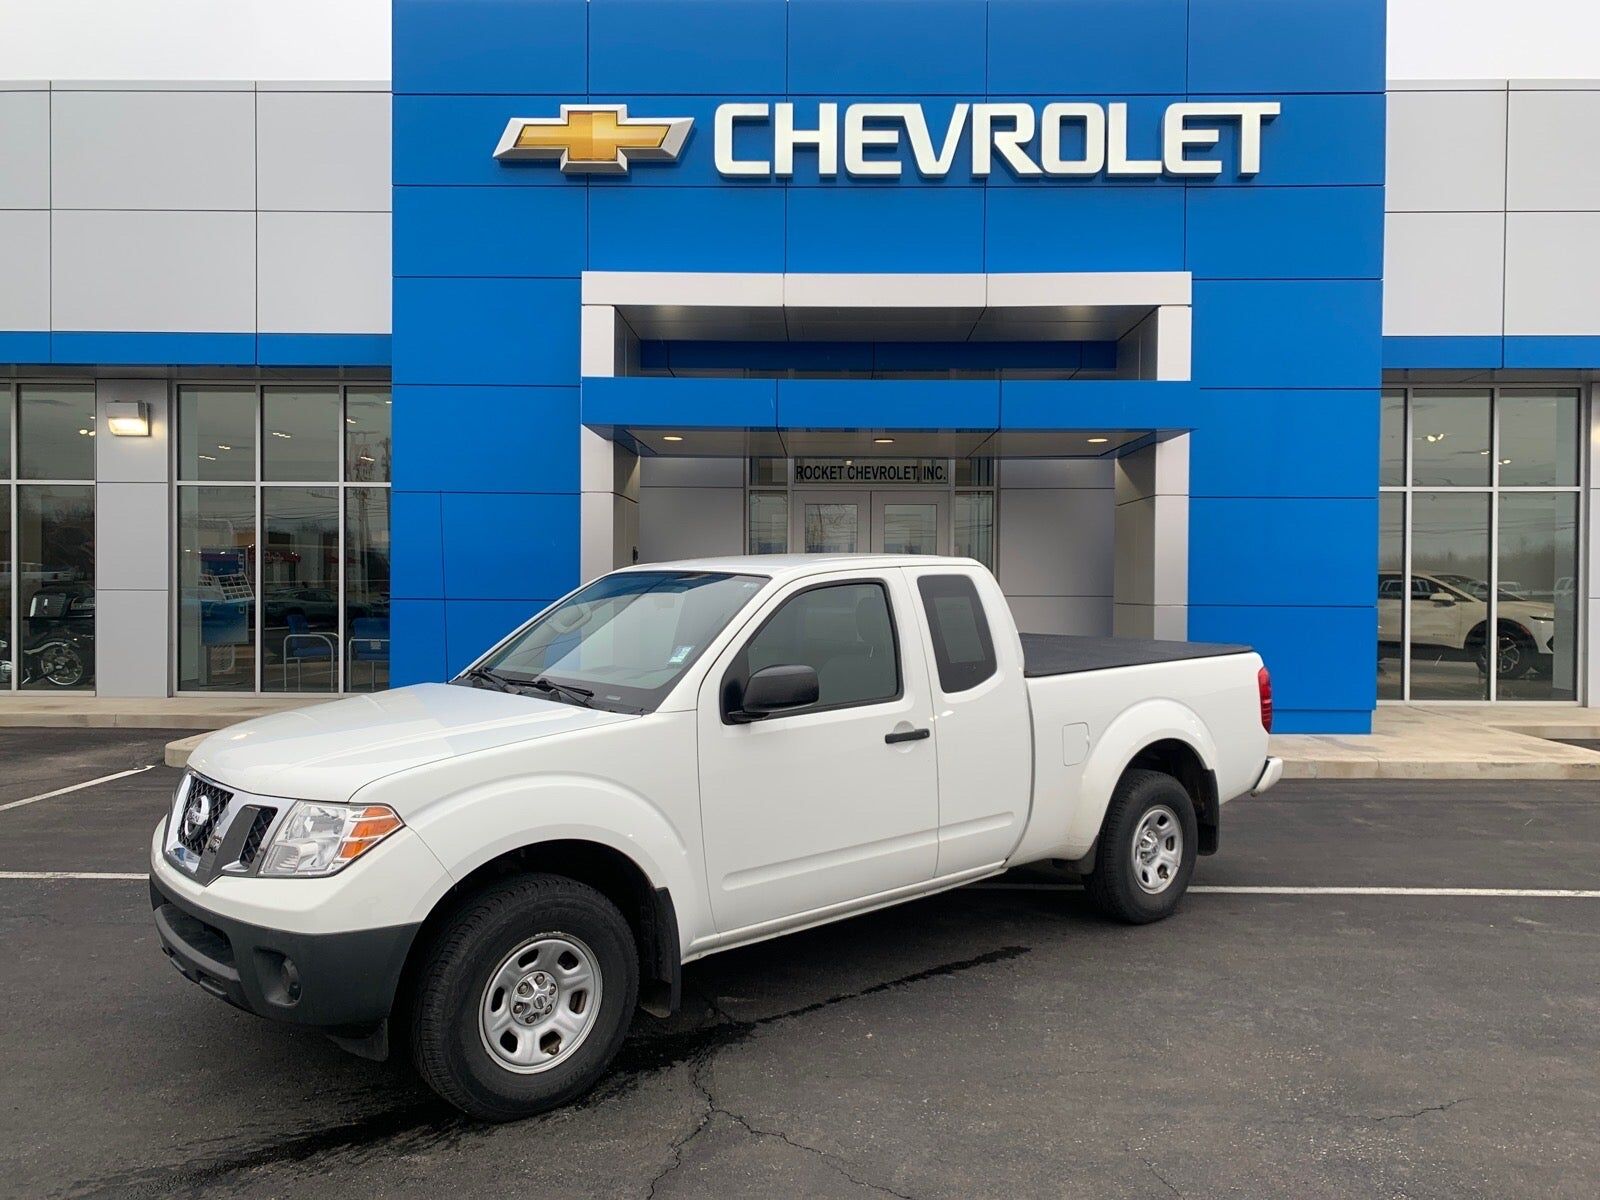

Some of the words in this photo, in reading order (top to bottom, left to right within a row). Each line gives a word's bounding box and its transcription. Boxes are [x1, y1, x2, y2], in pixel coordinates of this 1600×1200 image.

[714, 102, 1281, 176] CHEVROLET
[796, 465, 844, 480] ROCKET
[847, 465, 921, 482] CHEVROLET,
[923, 465, 946, 480] INC.
